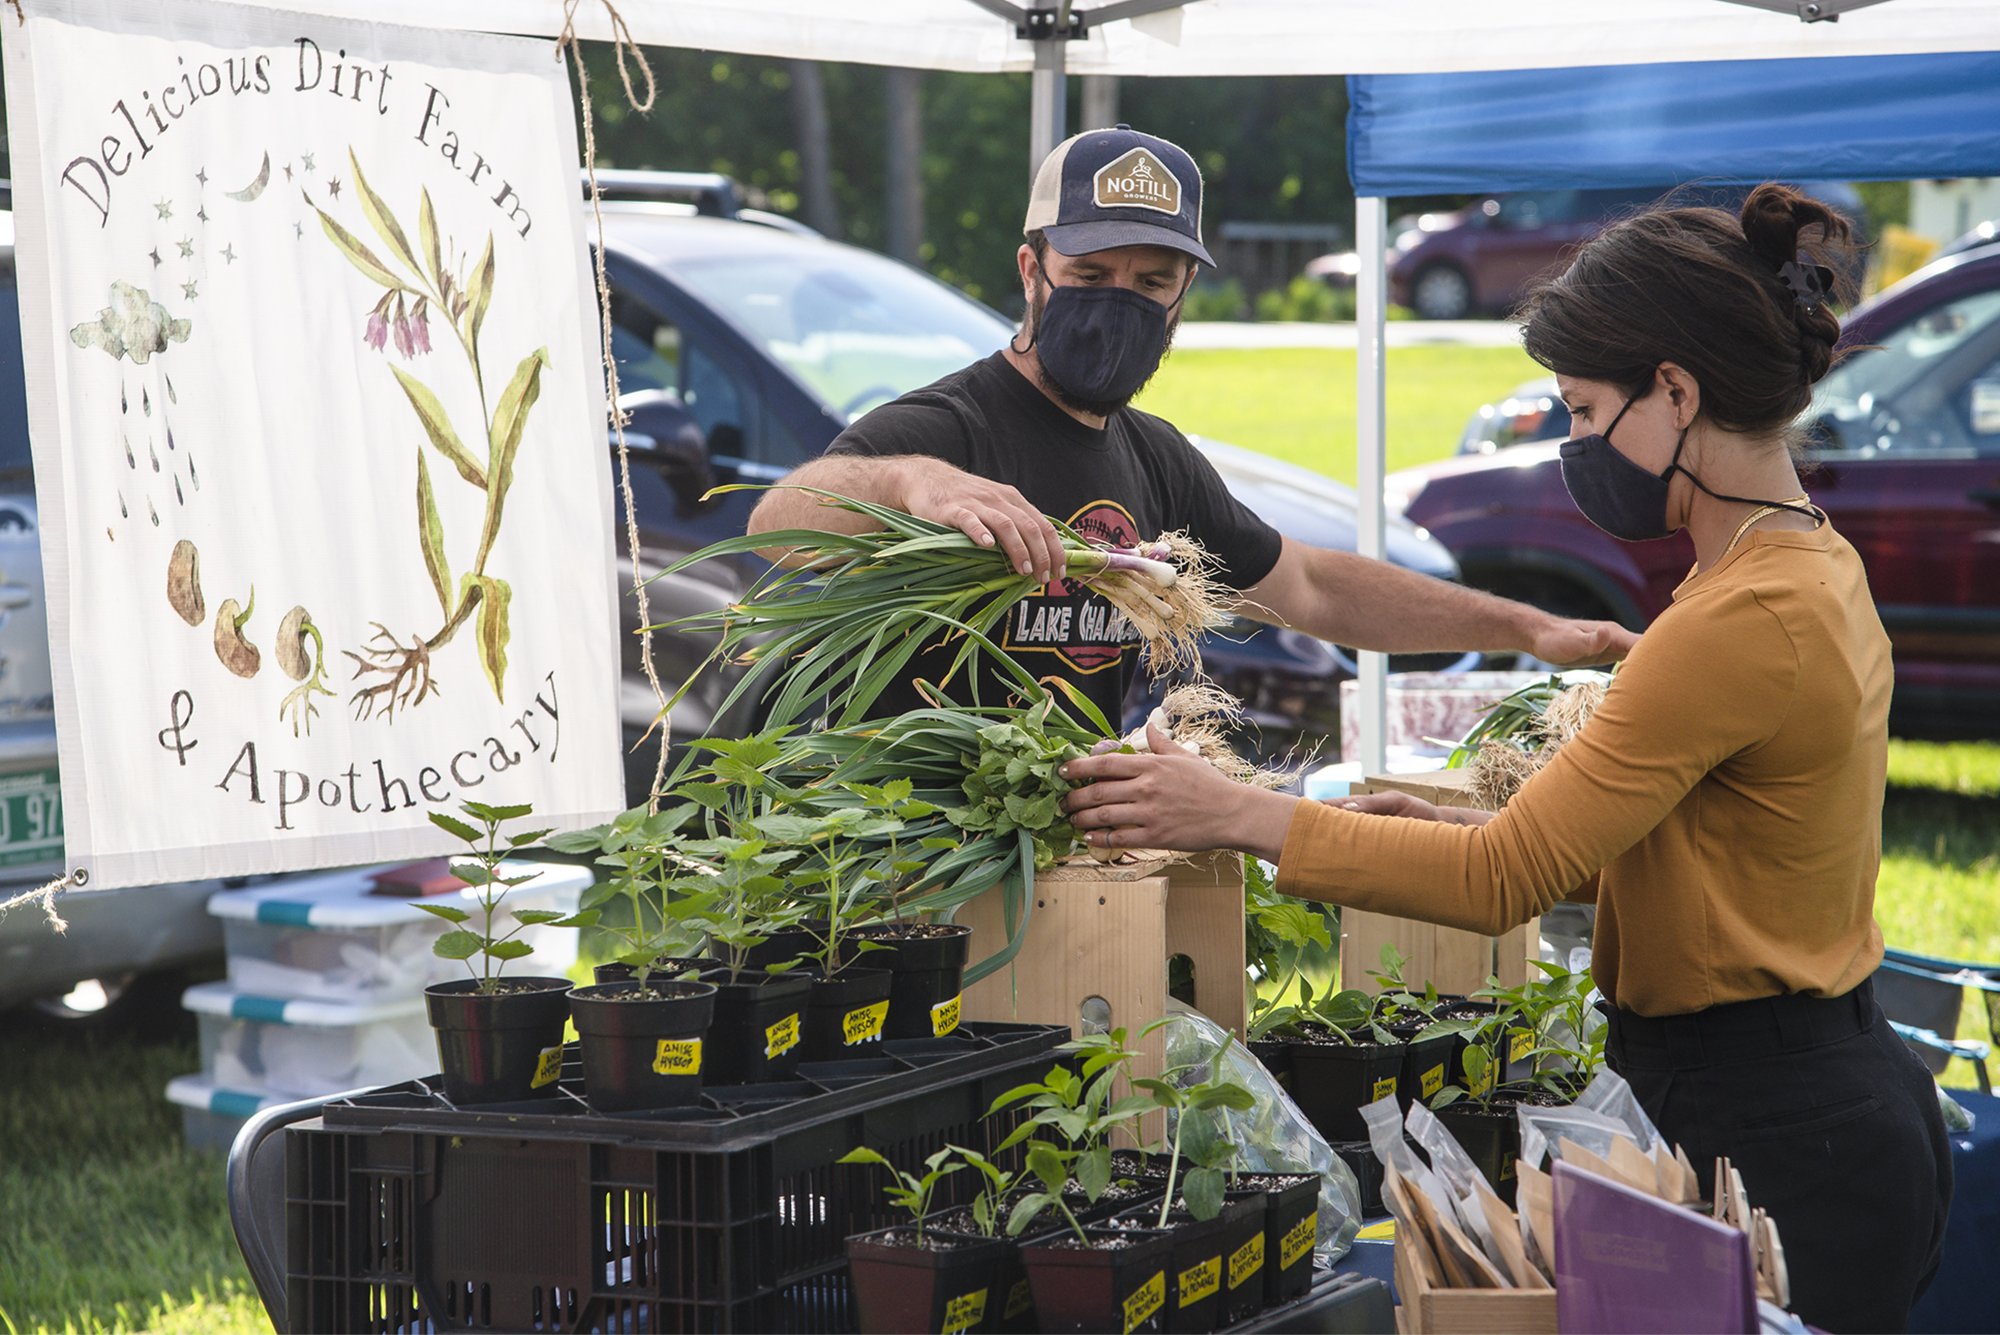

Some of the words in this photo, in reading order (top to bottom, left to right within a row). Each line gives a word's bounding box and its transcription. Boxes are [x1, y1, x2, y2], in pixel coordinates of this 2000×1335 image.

[60, 53, 271, 228] Delicious
[294, 37, 393, 115] Dirt
[414, 83, 534, 242] Farm
[1107, 177, 1172, 201] NO-TILL
[1124, 193, 1157, 202] GROWERS
[1015, 600, 1072, 642] LAKE
[158, 690, 198, 766] &
[213, 670, 561, 830] Apothecary
[26, 790, 63, 840] 97
[848, 1008, 873, 1024] ANISE
[772, 1018, 793, 1037] ANISE
[847, 1017, 877, 1038] HYSSOP
[664, 1043, 693, 1057] ANISE
[660, 1055, 693, 1070] HYSSOP
